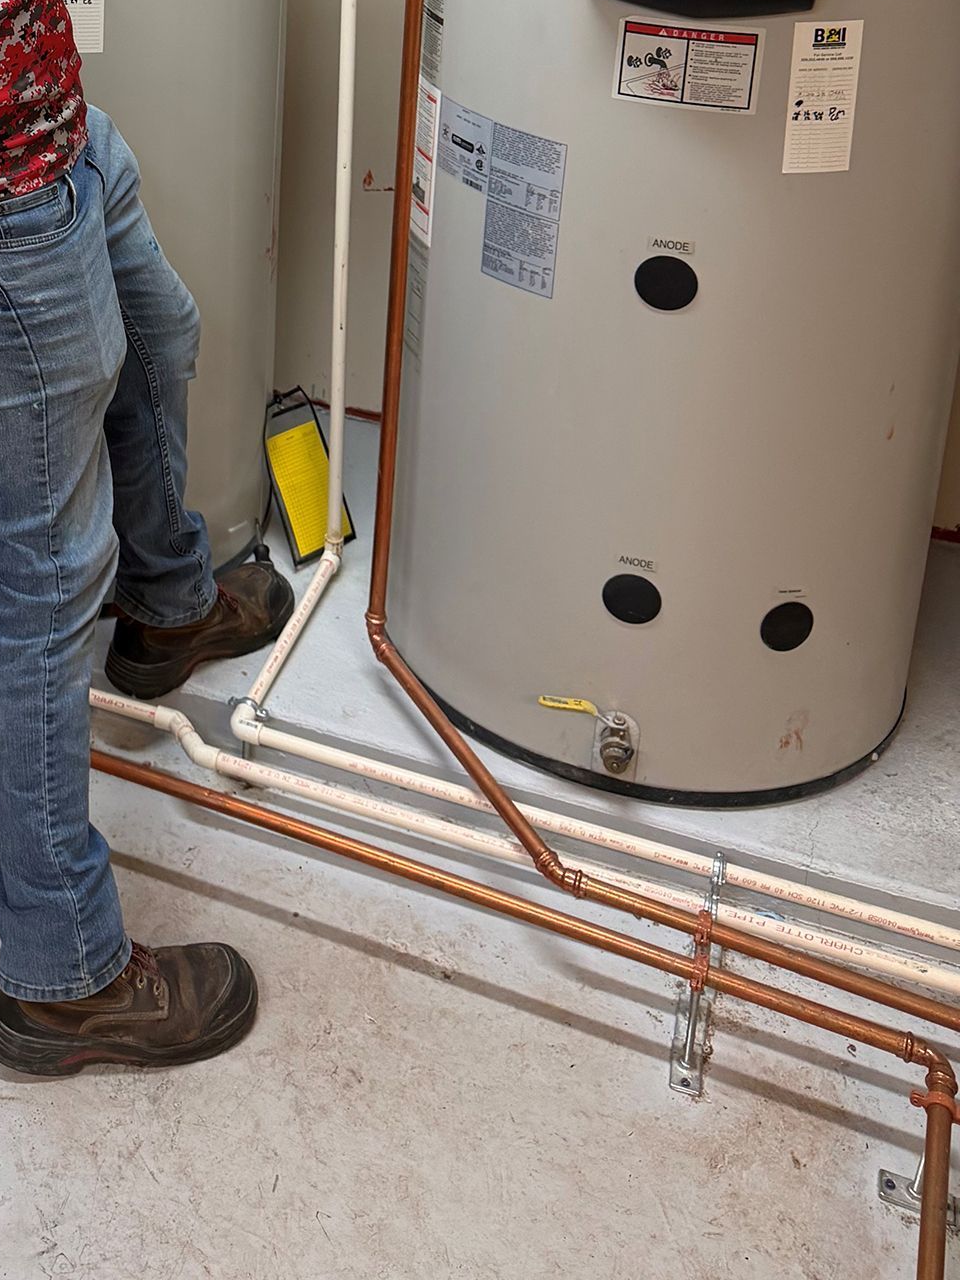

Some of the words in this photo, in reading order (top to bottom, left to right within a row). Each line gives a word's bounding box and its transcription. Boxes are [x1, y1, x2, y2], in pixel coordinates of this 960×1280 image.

[672, 30, 725, 41] DANGER
[652, 239, 690, 251] ANODE
[619, 556, 654, 569] ANODE
[807, 897, 825, 907] 1120
[776, 925, 864, 956] CHARLOTTE
